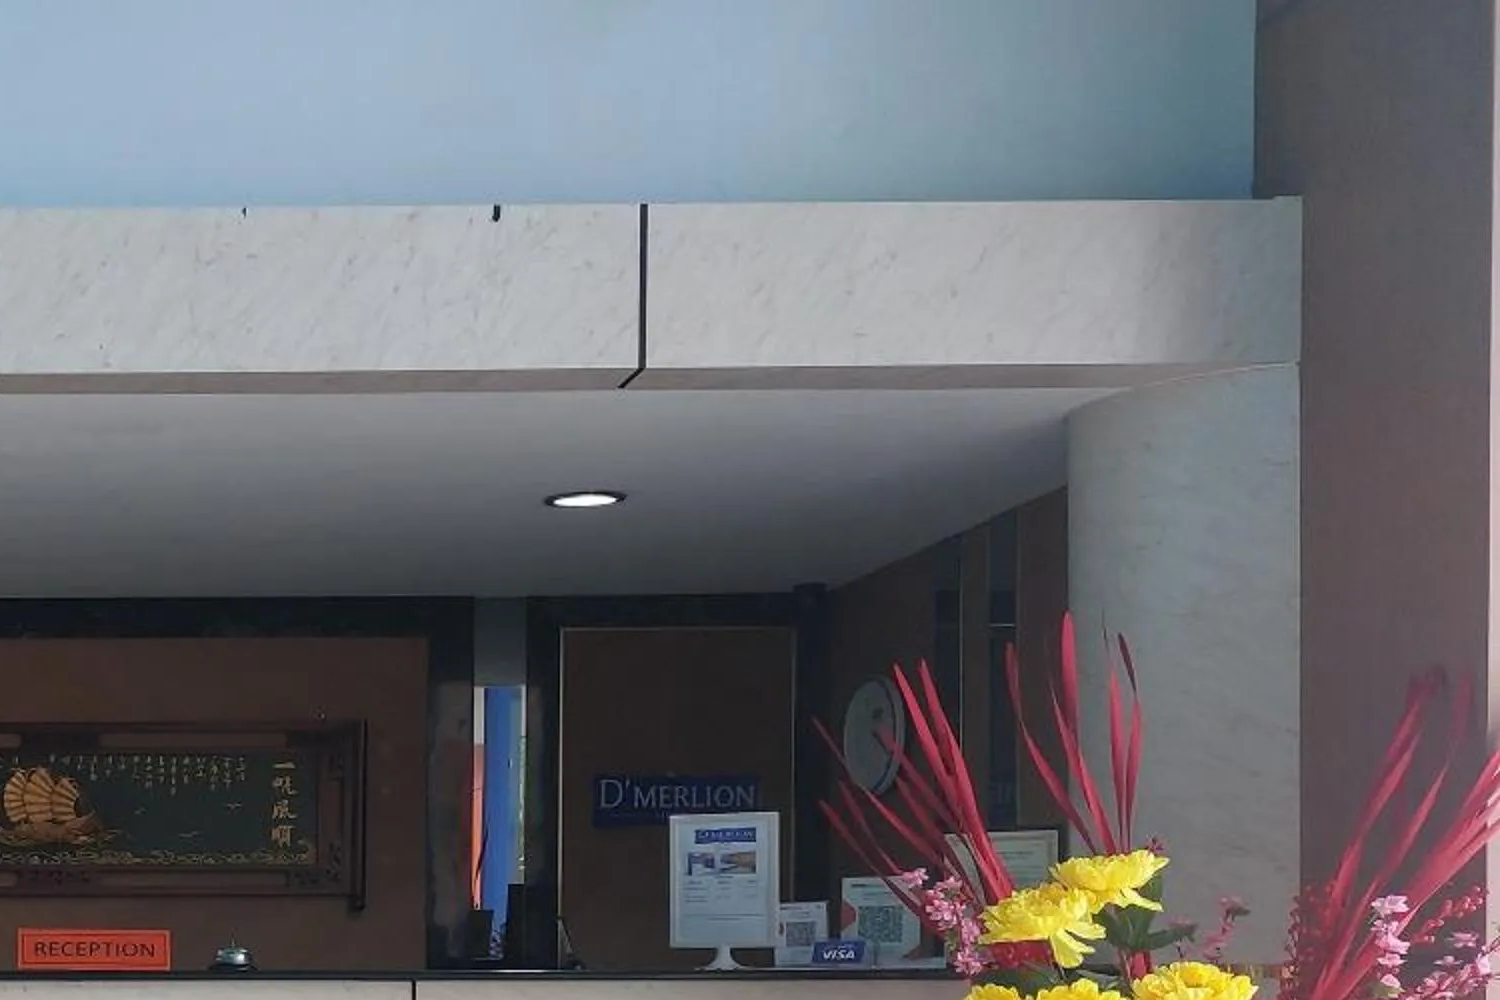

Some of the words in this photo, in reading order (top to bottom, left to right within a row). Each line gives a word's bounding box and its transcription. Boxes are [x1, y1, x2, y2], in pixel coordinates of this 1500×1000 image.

[599, 778, 756, 809] D'MERLION
[34, 941, 156, 958] RECEPTION
[823, 949, 855, 960] VISA
